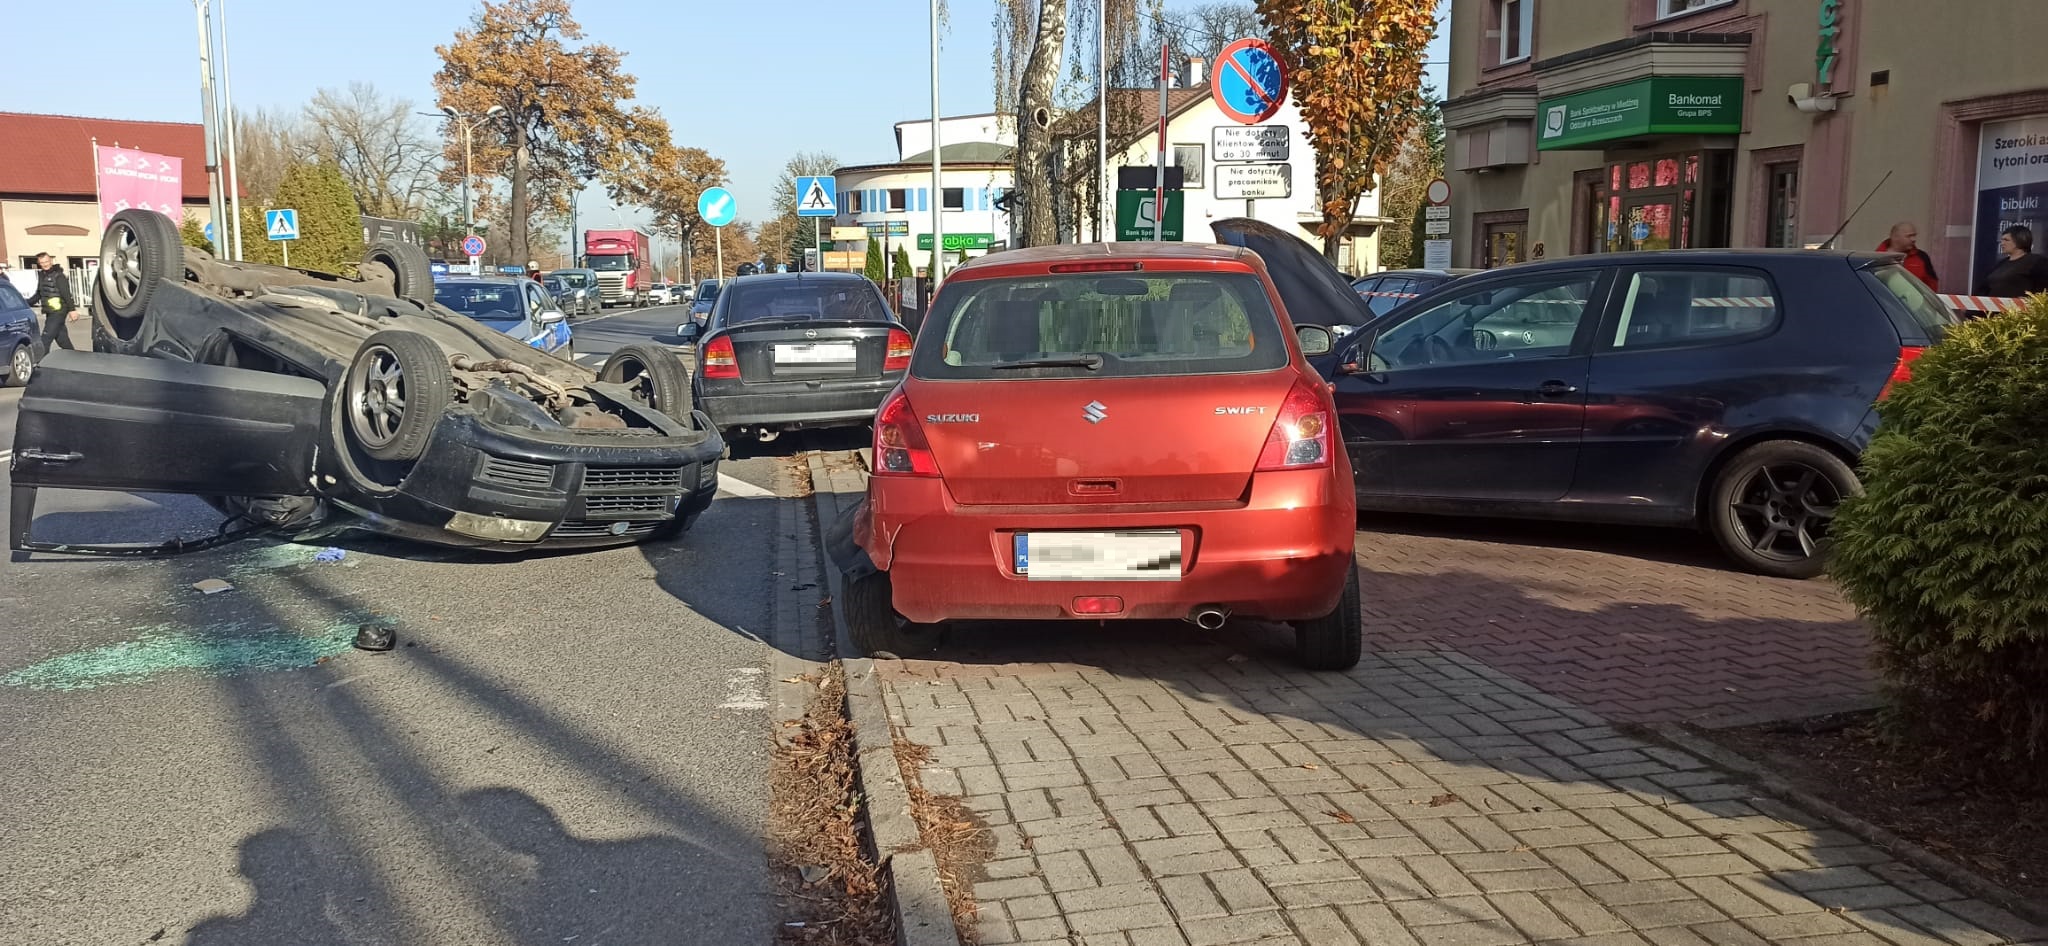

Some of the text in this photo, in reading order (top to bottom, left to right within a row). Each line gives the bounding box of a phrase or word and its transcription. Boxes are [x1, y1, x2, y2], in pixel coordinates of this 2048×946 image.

[1669, 93, 1722, 105] Bankomat
[1677, 109, 1712, 118] Grupa BPS
[1245, 129, 1277, 138] dotyczy
[1259, 139, 1287, 147] Banku
[1994, 134, 2037, 149] Szeroki
[1240, 150, 1251, 158] 30
[1993, 153, 2028, 170] tytoni
[1247, 168, 1276, 176] dotyczy
[2001, 196, 2038, 210] bibułki
[941, 235, 974, 247] abka
[451, 264, 478, 272] POLICJA
[1214, 406, 1267, 415] SWIFT
[927, 414, 979, 423] SUZUKI
[1019, 554, 1028, 563] PL
